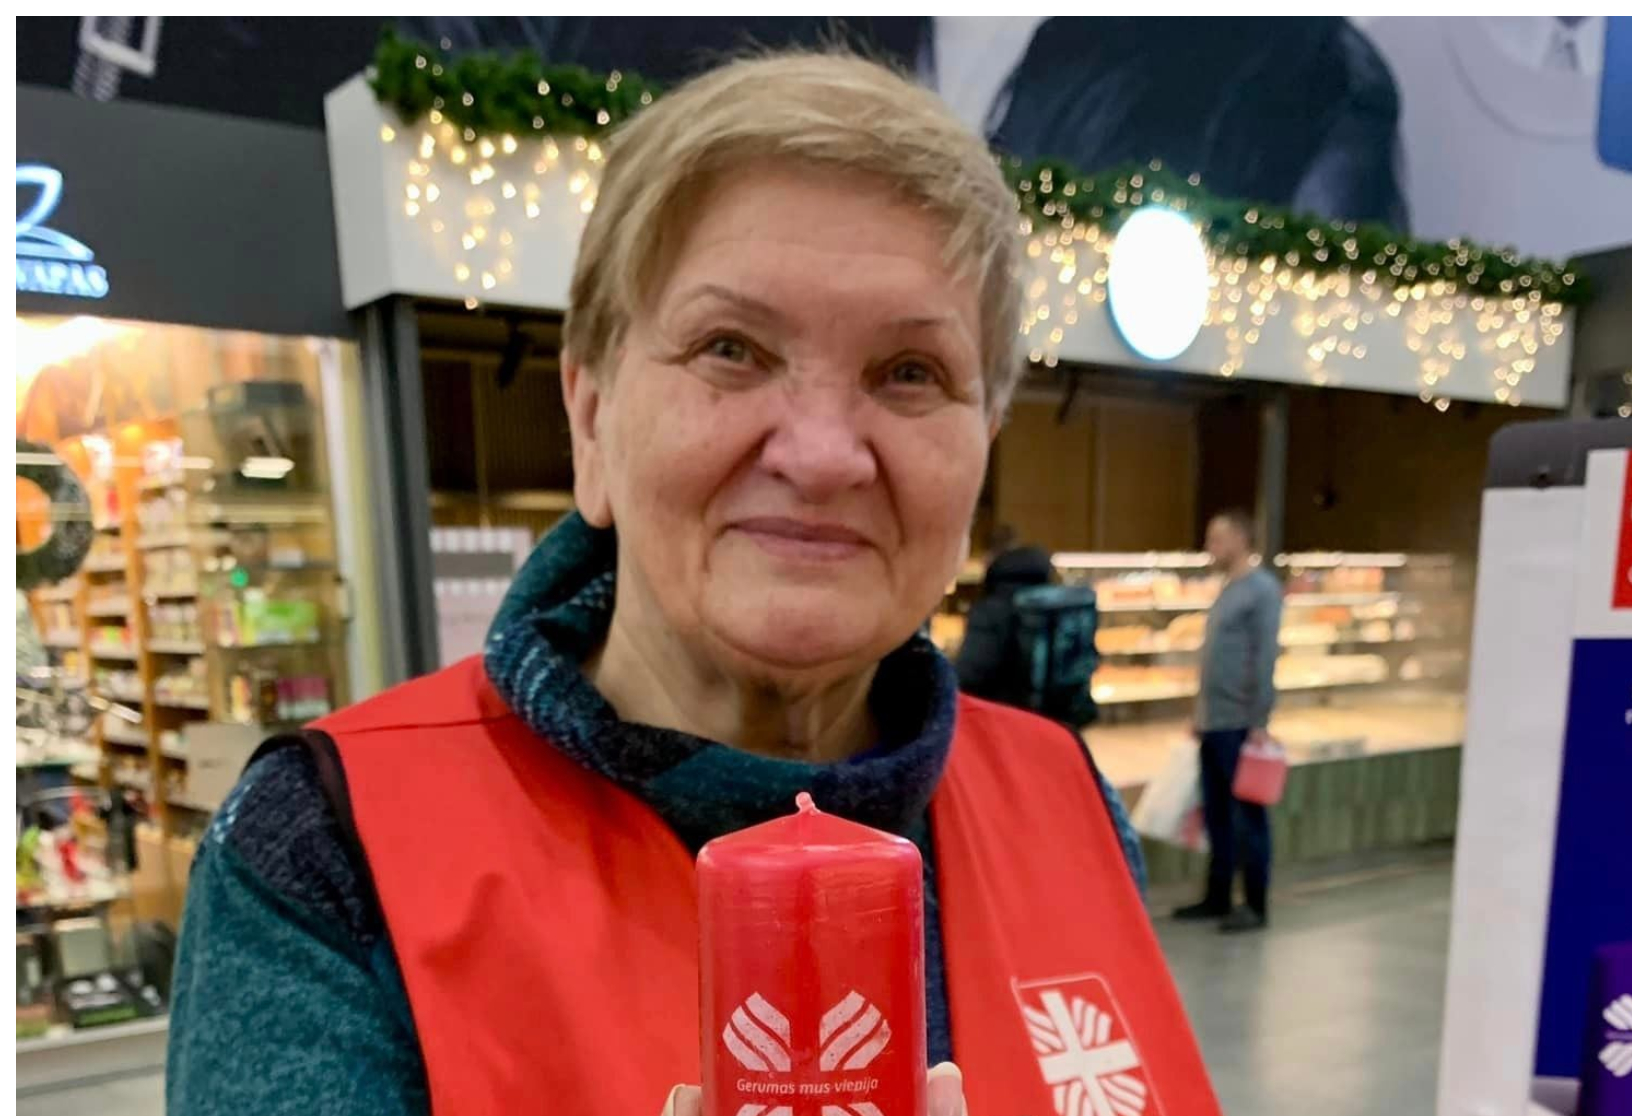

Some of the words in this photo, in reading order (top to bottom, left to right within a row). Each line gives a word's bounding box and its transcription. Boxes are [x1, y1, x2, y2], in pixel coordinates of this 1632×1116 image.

[736, 1077, 795, 1095] Gerumas
[799, 1080, 831, 1094] mus
[834, 1076, 879, 1095] vienija
